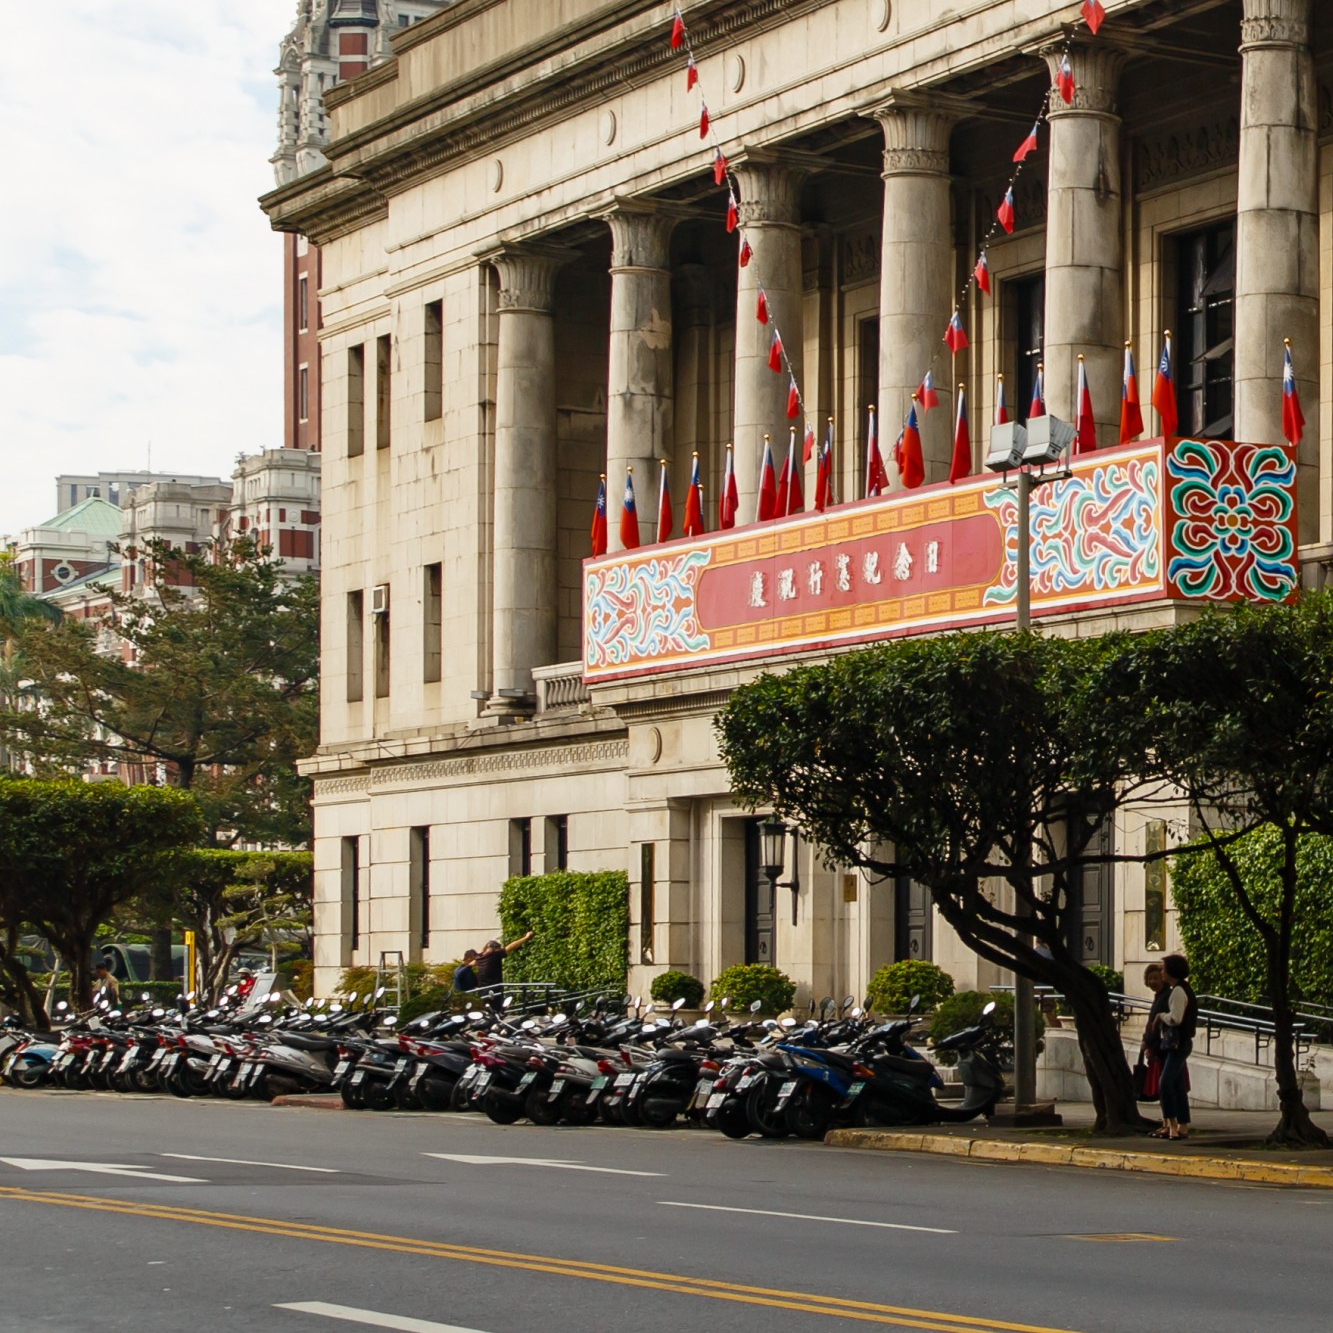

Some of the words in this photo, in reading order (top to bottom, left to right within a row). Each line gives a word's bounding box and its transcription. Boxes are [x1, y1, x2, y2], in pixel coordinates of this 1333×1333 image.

[749, 540, 939, 607] 慶祝行憲紀念日
